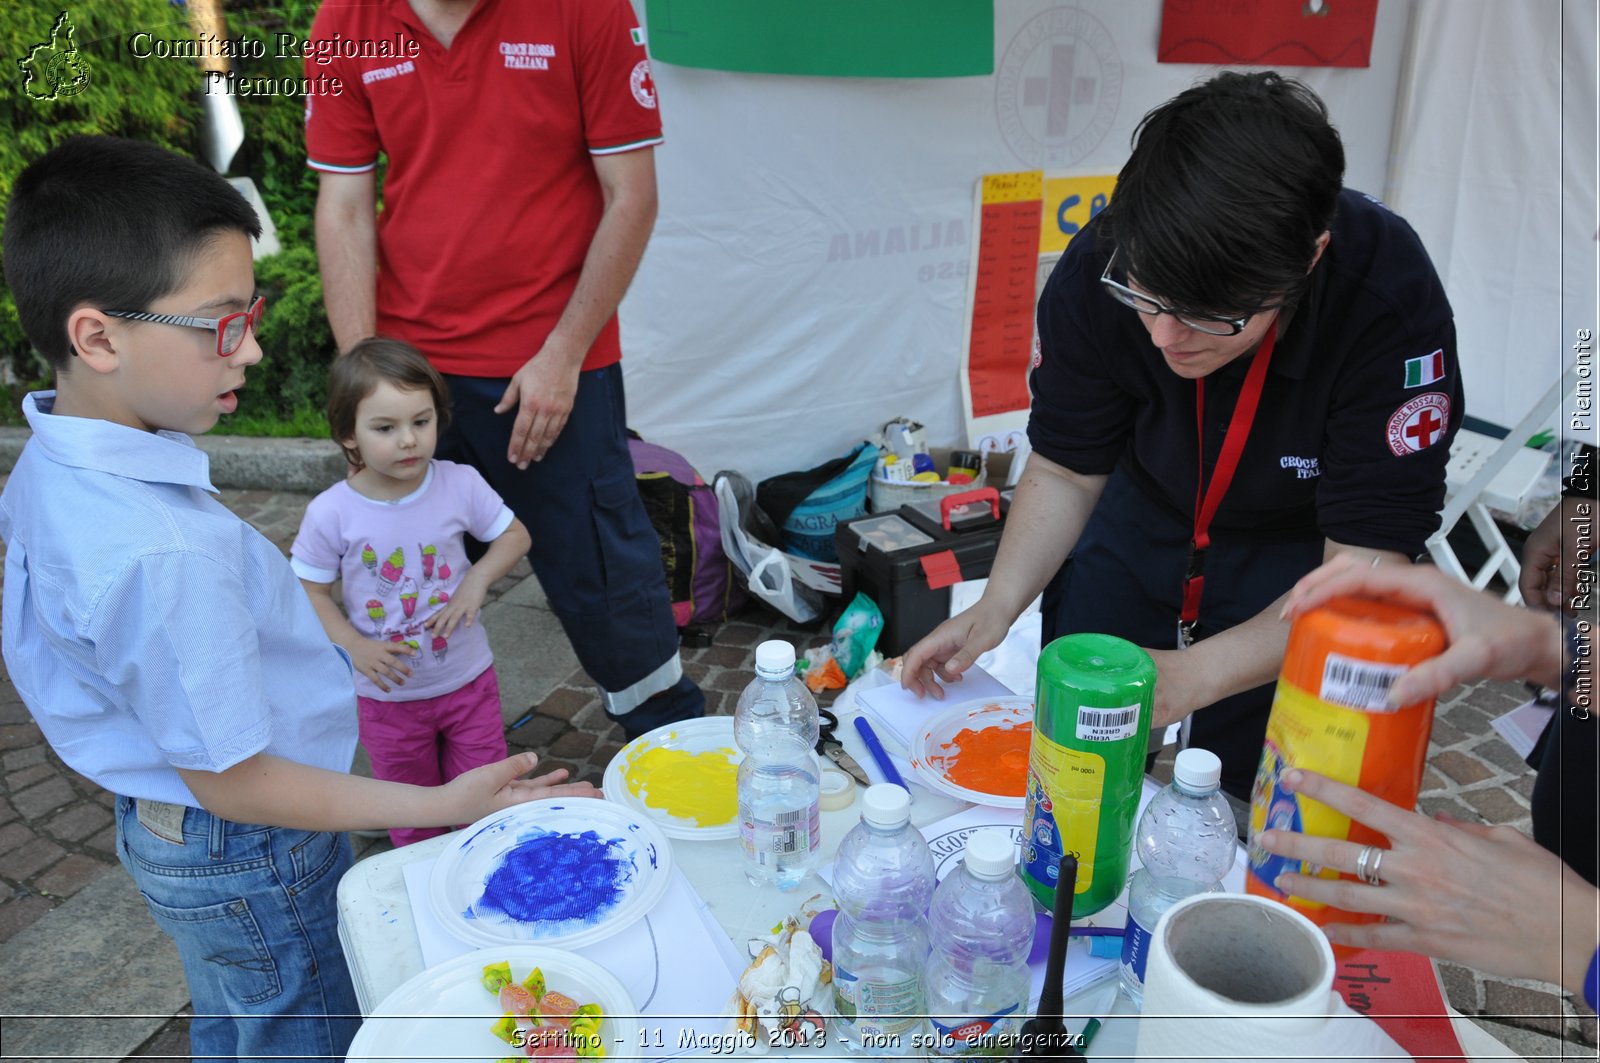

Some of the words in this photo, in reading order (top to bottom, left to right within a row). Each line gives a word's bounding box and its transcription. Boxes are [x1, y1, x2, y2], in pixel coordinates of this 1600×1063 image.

[1390, 410, 1409, 435] CROCE
[1407, 396, 1434, 412] ROSSA
[1280, 456, 1319, 469] CROCE
[793, 512, 839, 530] AGRA
[931, 828, 980, 860] AGOST
[1130, 927, 1141, 964] SPAREA
[958, 1024, 983, 1037] coop
